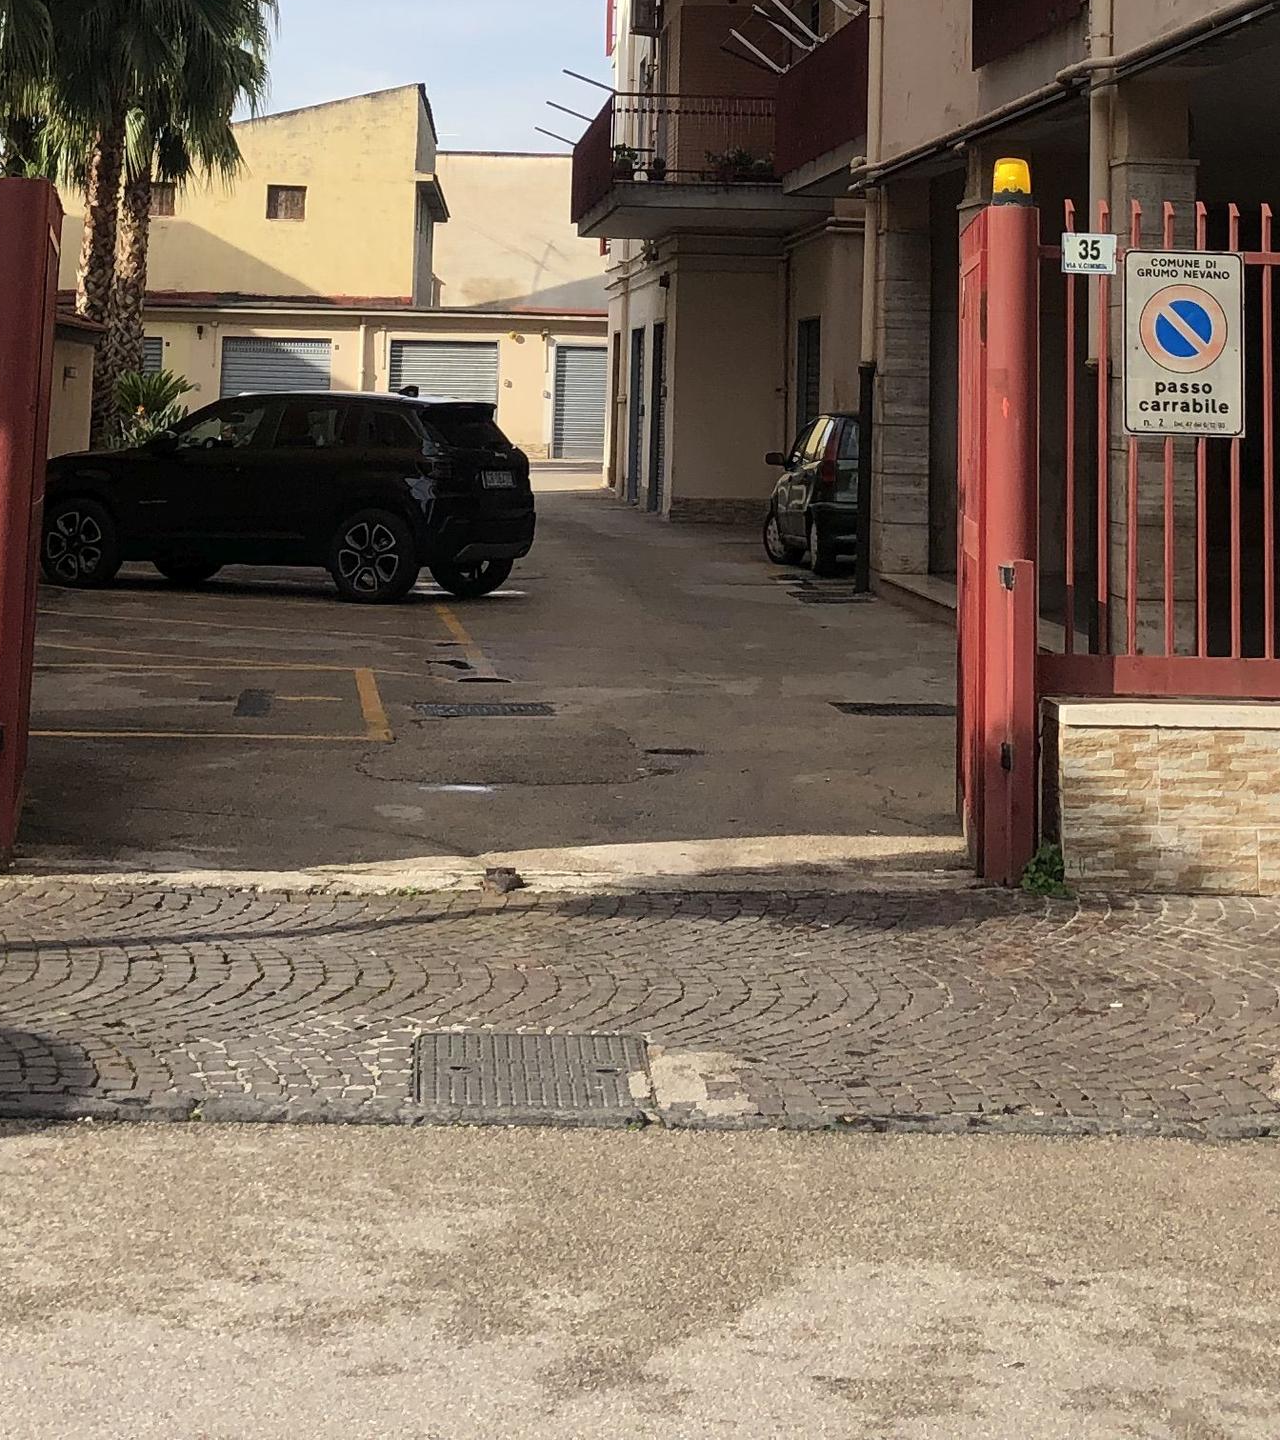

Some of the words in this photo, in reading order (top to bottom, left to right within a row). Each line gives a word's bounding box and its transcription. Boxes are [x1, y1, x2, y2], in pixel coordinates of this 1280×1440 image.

[1078, 239, 1101, 261] 35
[1150, 258, 1200, 269] COMUNE
[1205, 260, 1217, 269] DI
[1136, 268, 1179, 278] GRUMO
[1183, 270, 1231, 280] NEVANO
[1155, 381, 1213, 396] passo
[1139, 398, 1230, 414] carrabile
